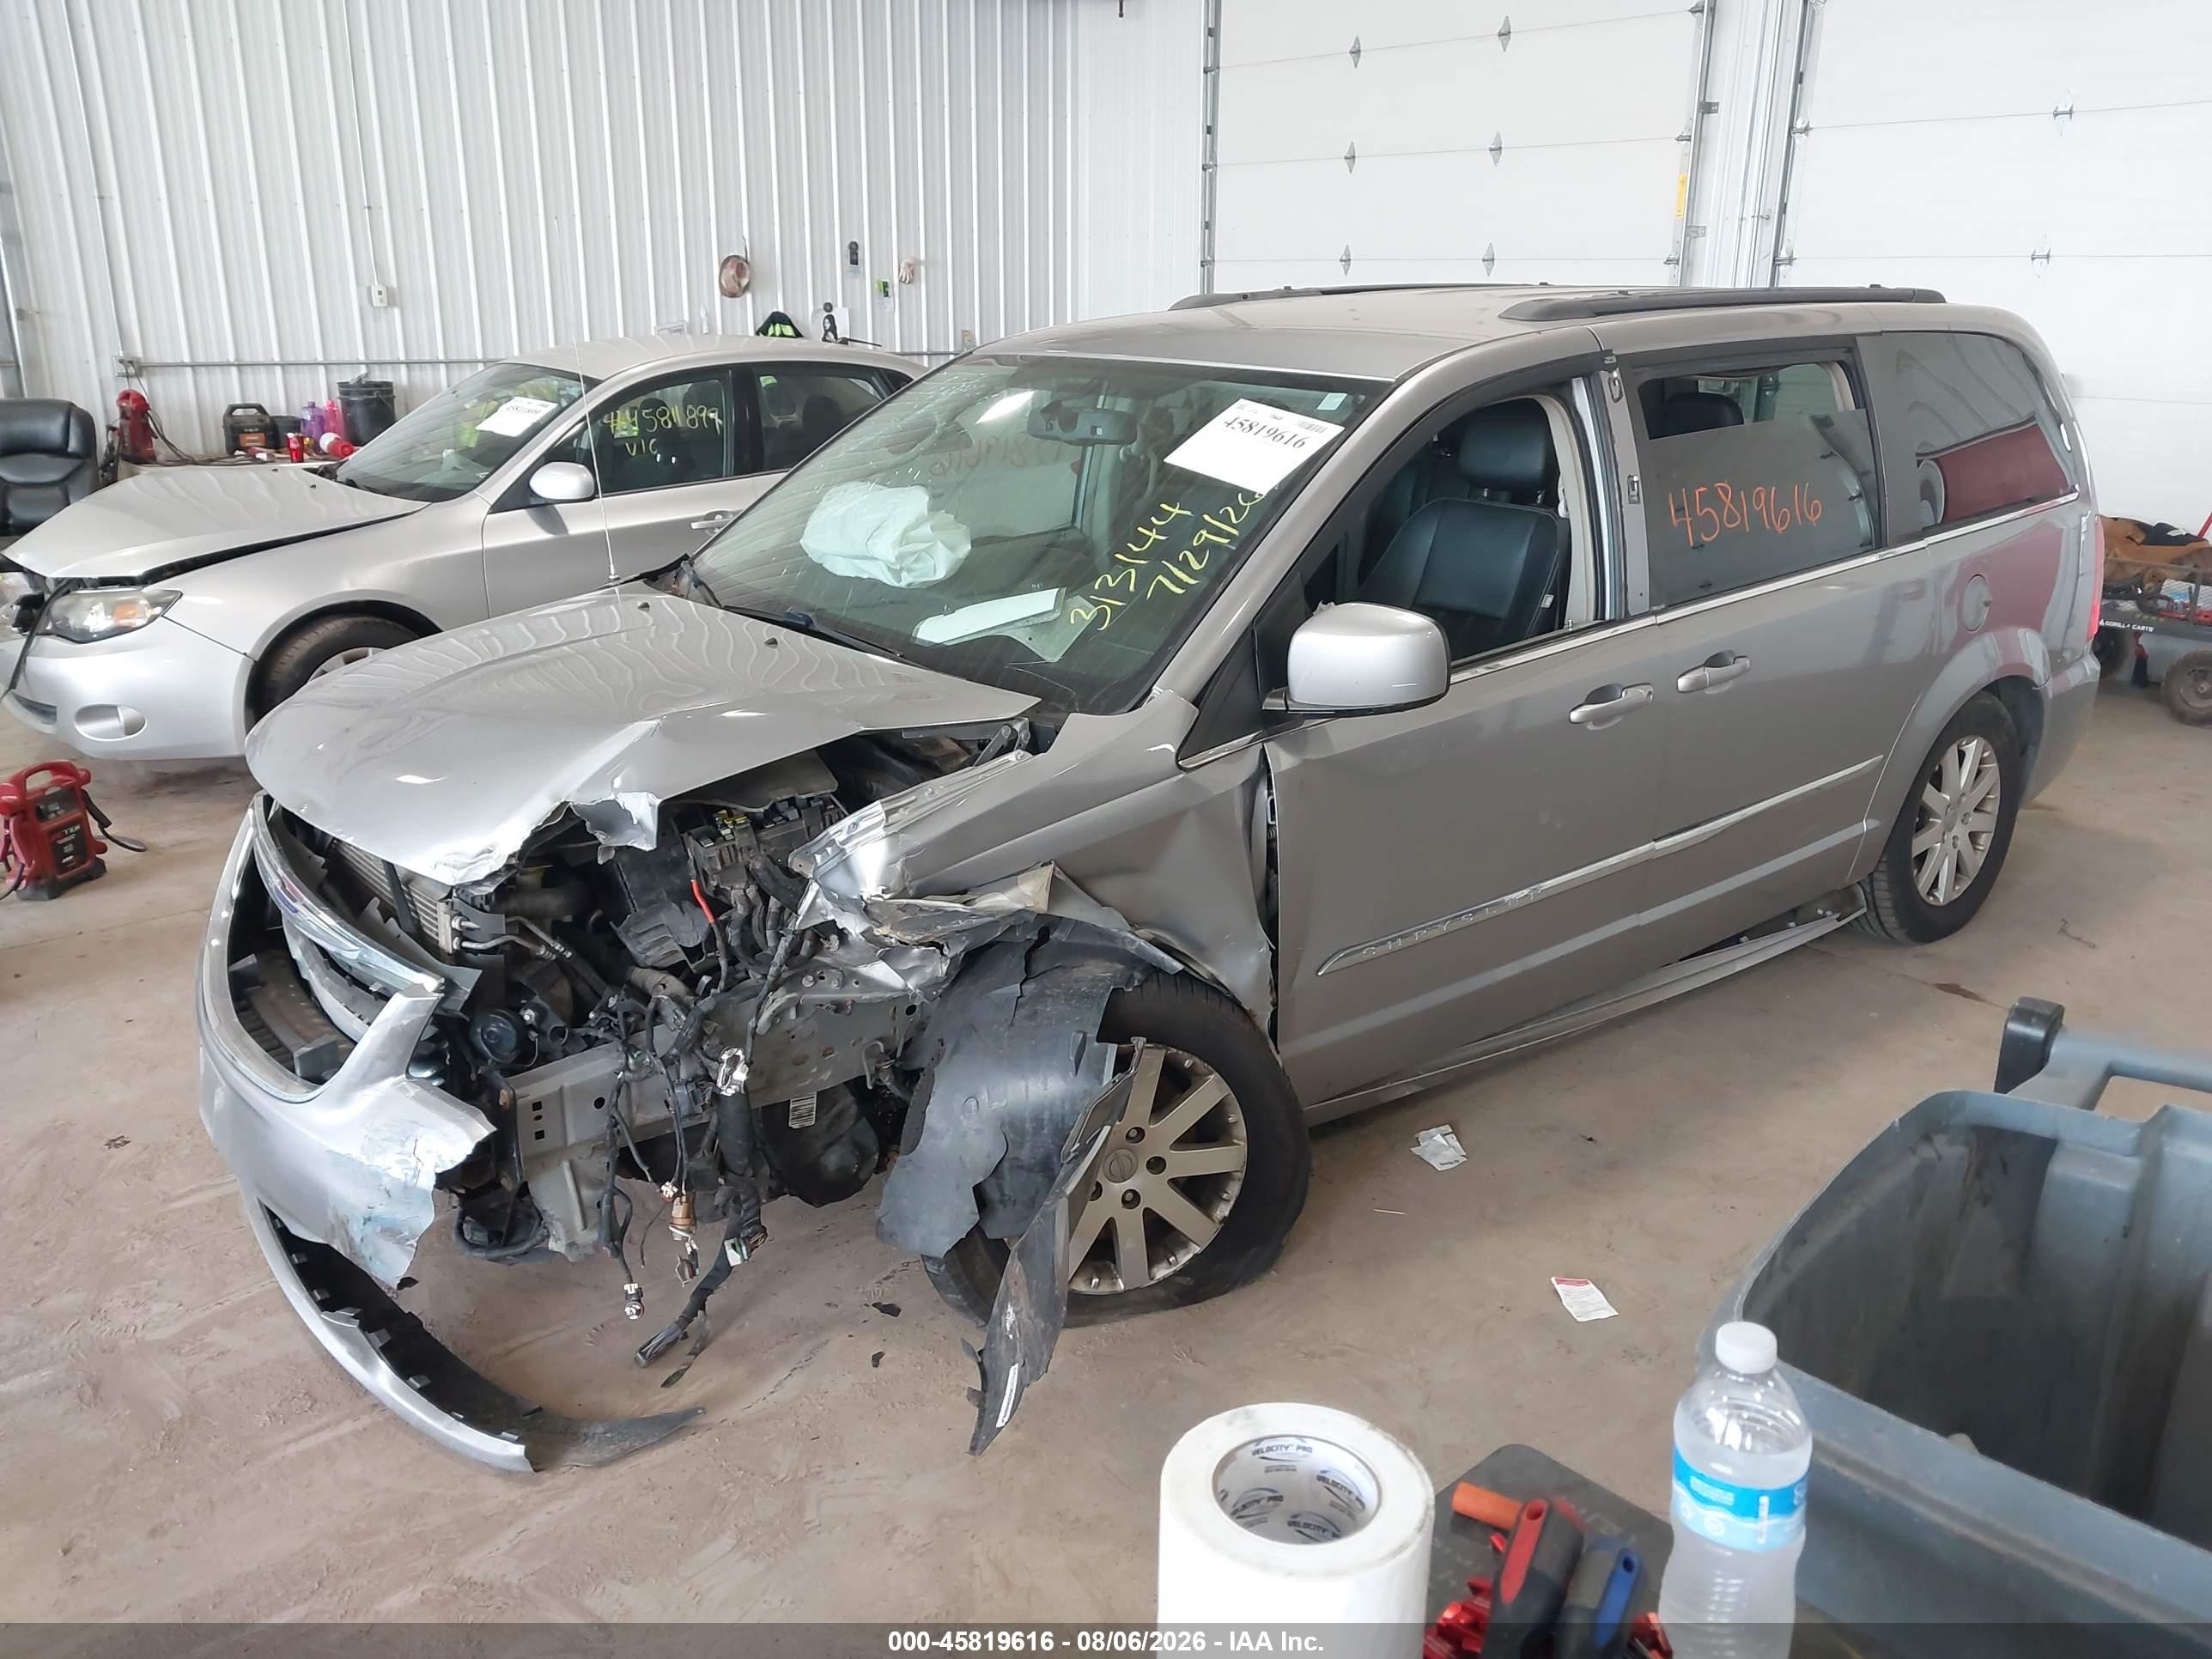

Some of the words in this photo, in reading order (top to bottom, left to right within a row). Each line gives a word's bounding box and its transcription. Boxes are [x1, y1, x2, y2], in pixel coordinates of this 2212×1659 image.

[1224, 416, 1308, 449] 45819616
[1669, 483, 1822, 549] 45819616
[1070, 502, 1194, 631] 313144
[1296, 1444, 1313, 1454] PRO
